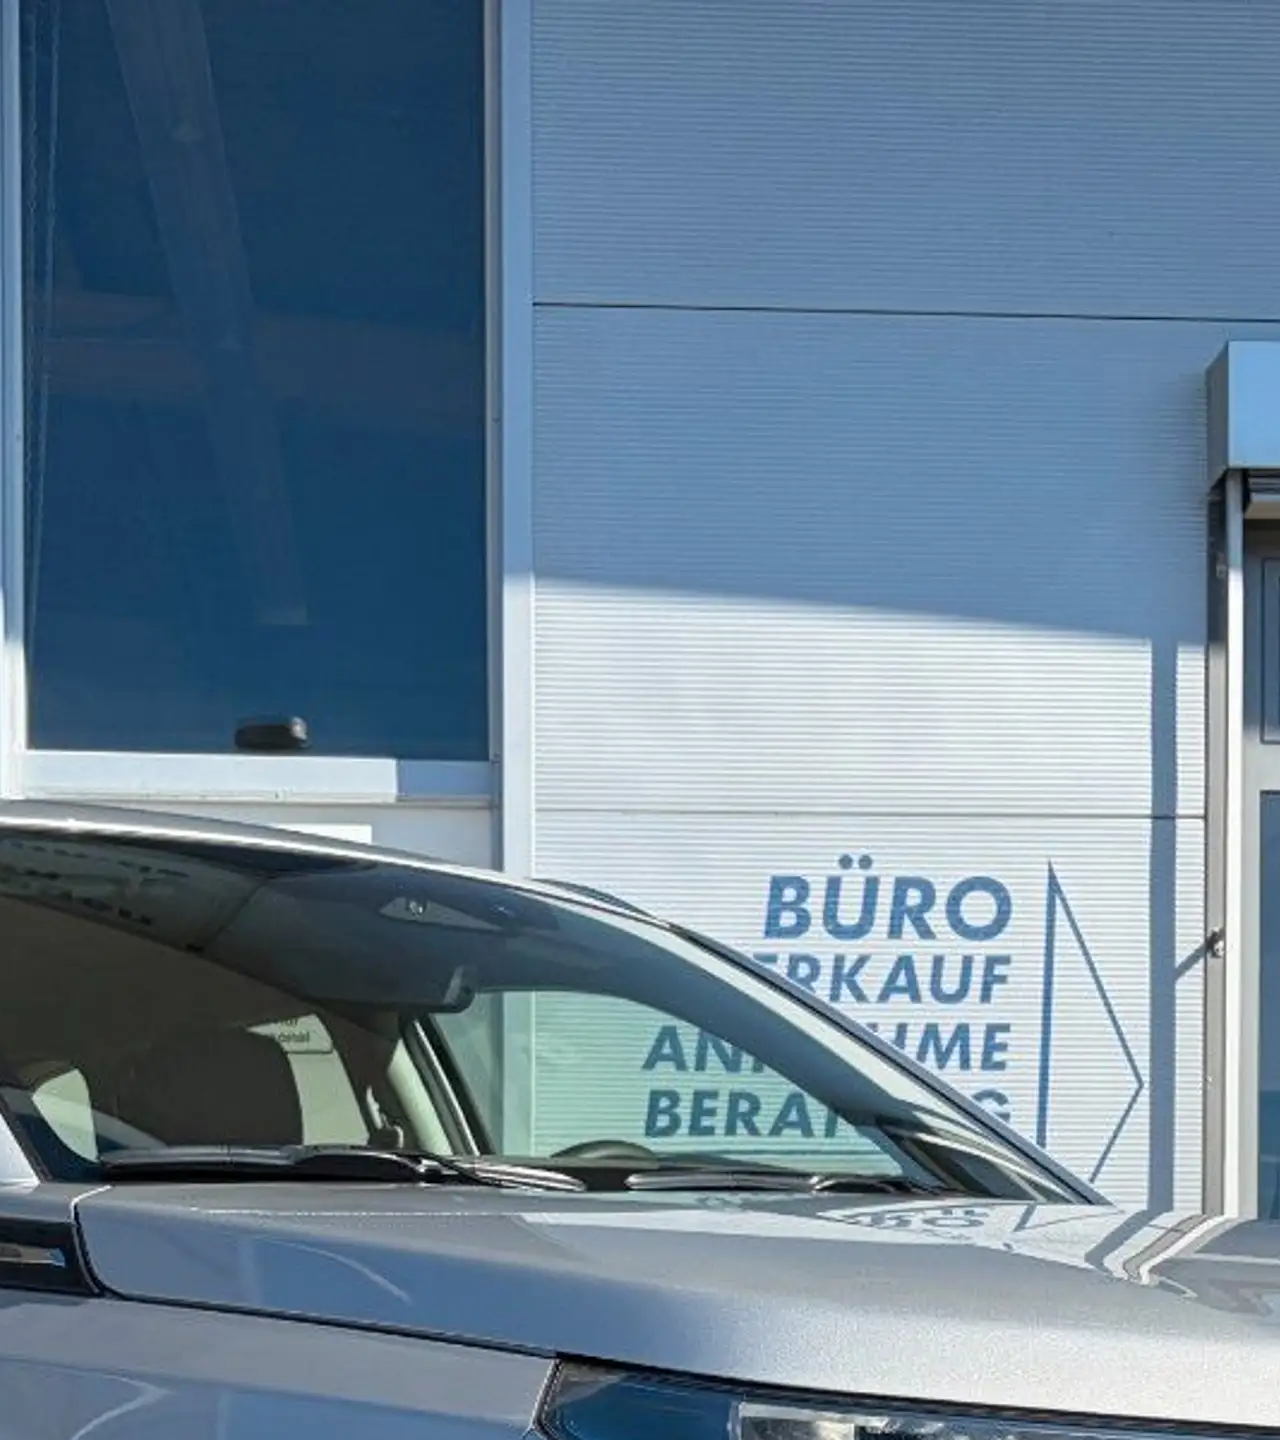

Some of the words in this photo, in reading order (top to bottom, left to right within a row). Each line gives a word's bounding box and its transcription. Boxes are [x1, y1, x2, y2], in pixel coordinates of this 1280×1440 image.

[762, 854, 1013, 942] BÜRO
[753, 952, 1012, 1005] RKAUF
[641, 1022, 1012, 1073] ANME
